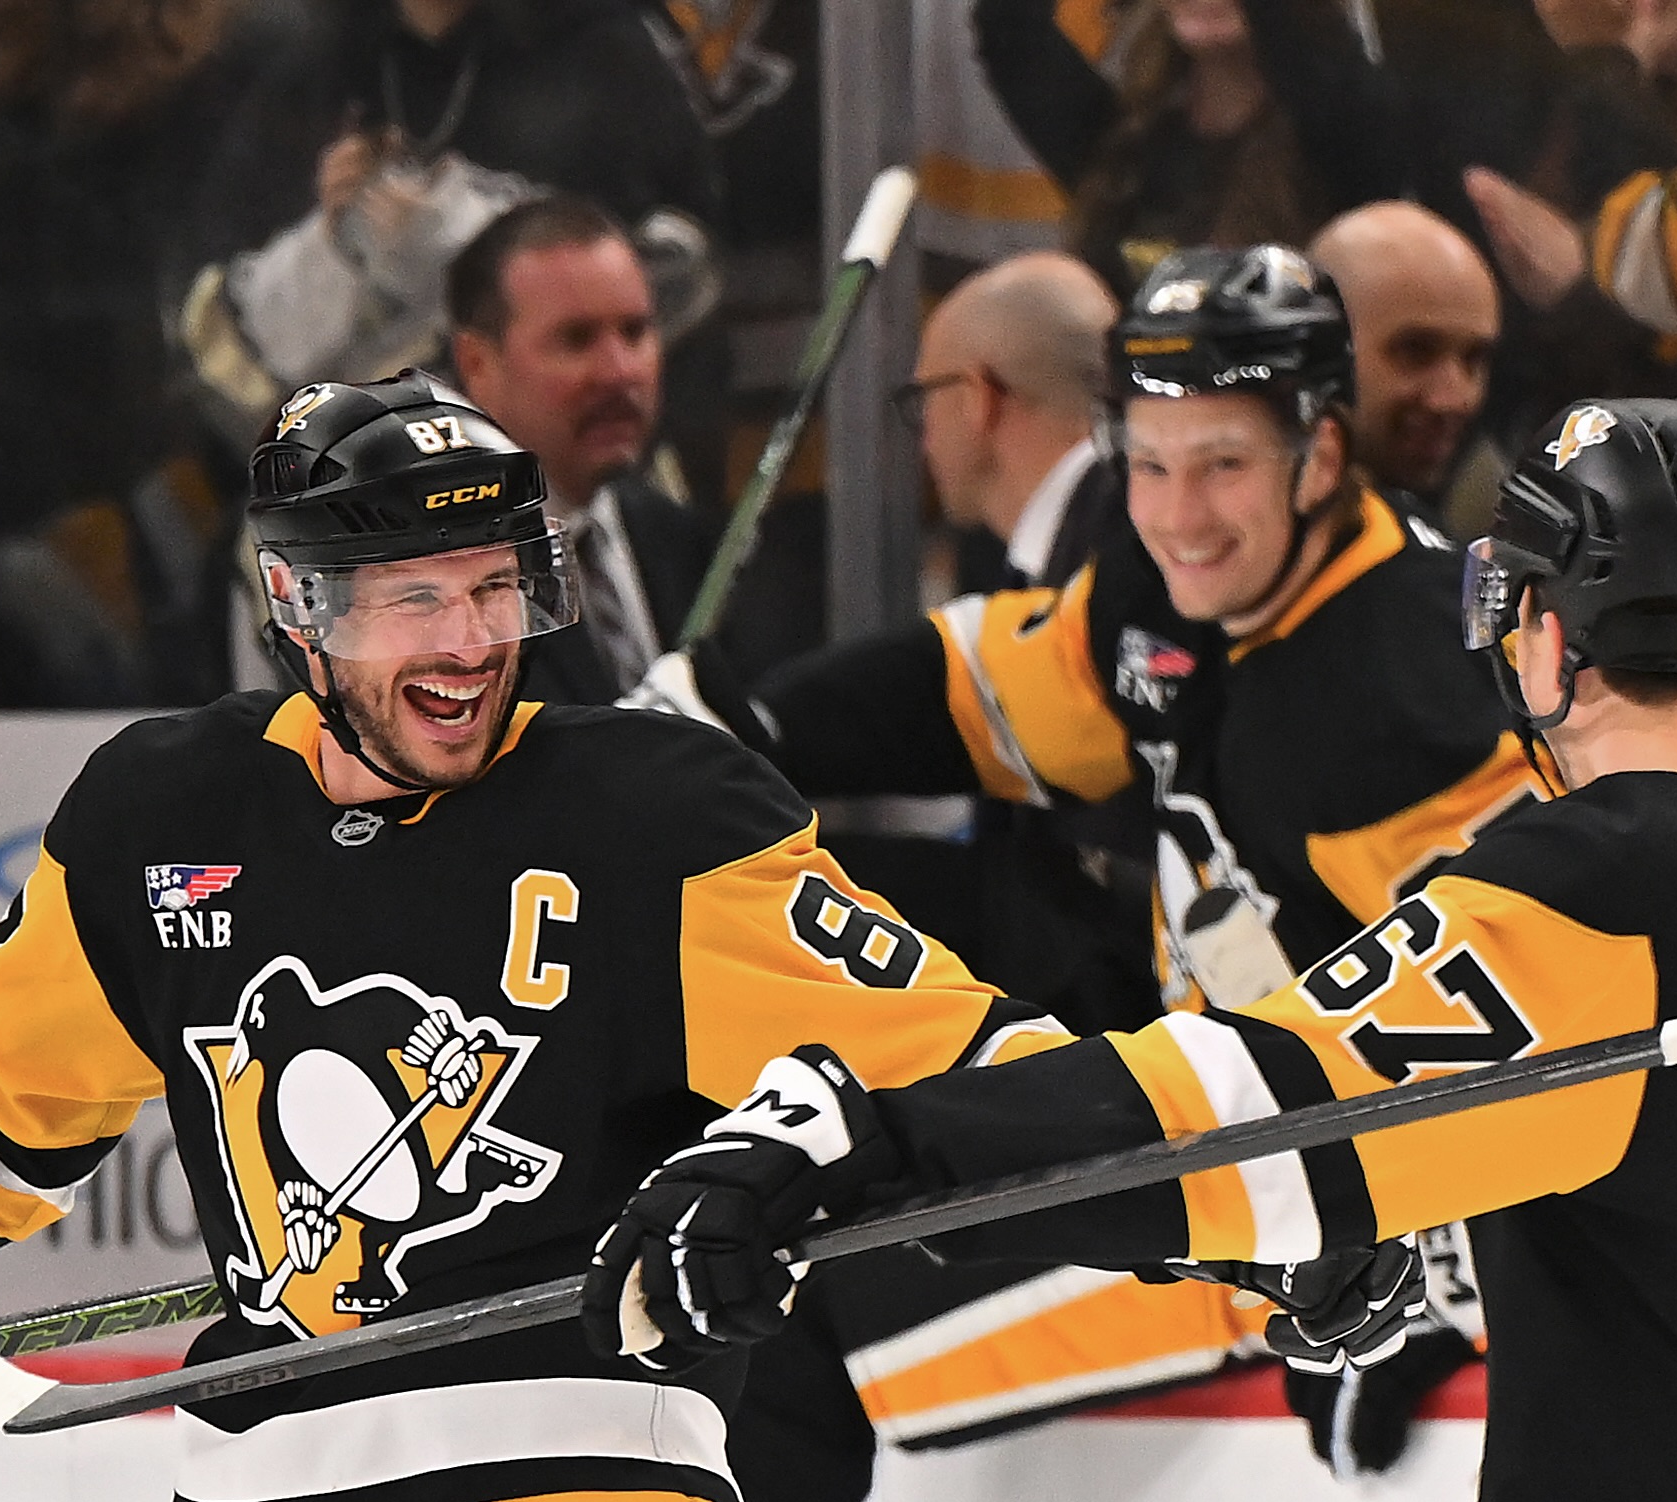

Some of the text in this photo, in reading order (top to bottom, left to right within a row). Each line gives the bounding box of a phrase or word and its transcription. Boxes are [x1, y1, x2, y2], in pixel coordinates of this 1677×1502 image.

[404, 416, 472, 454] 87
[425, 483, 500, 509] CCM
[152, 911, 231, 949] F.N.B.
[500, 869, 580, 1010] C
[1297, 891, 1539, 1087] 67
